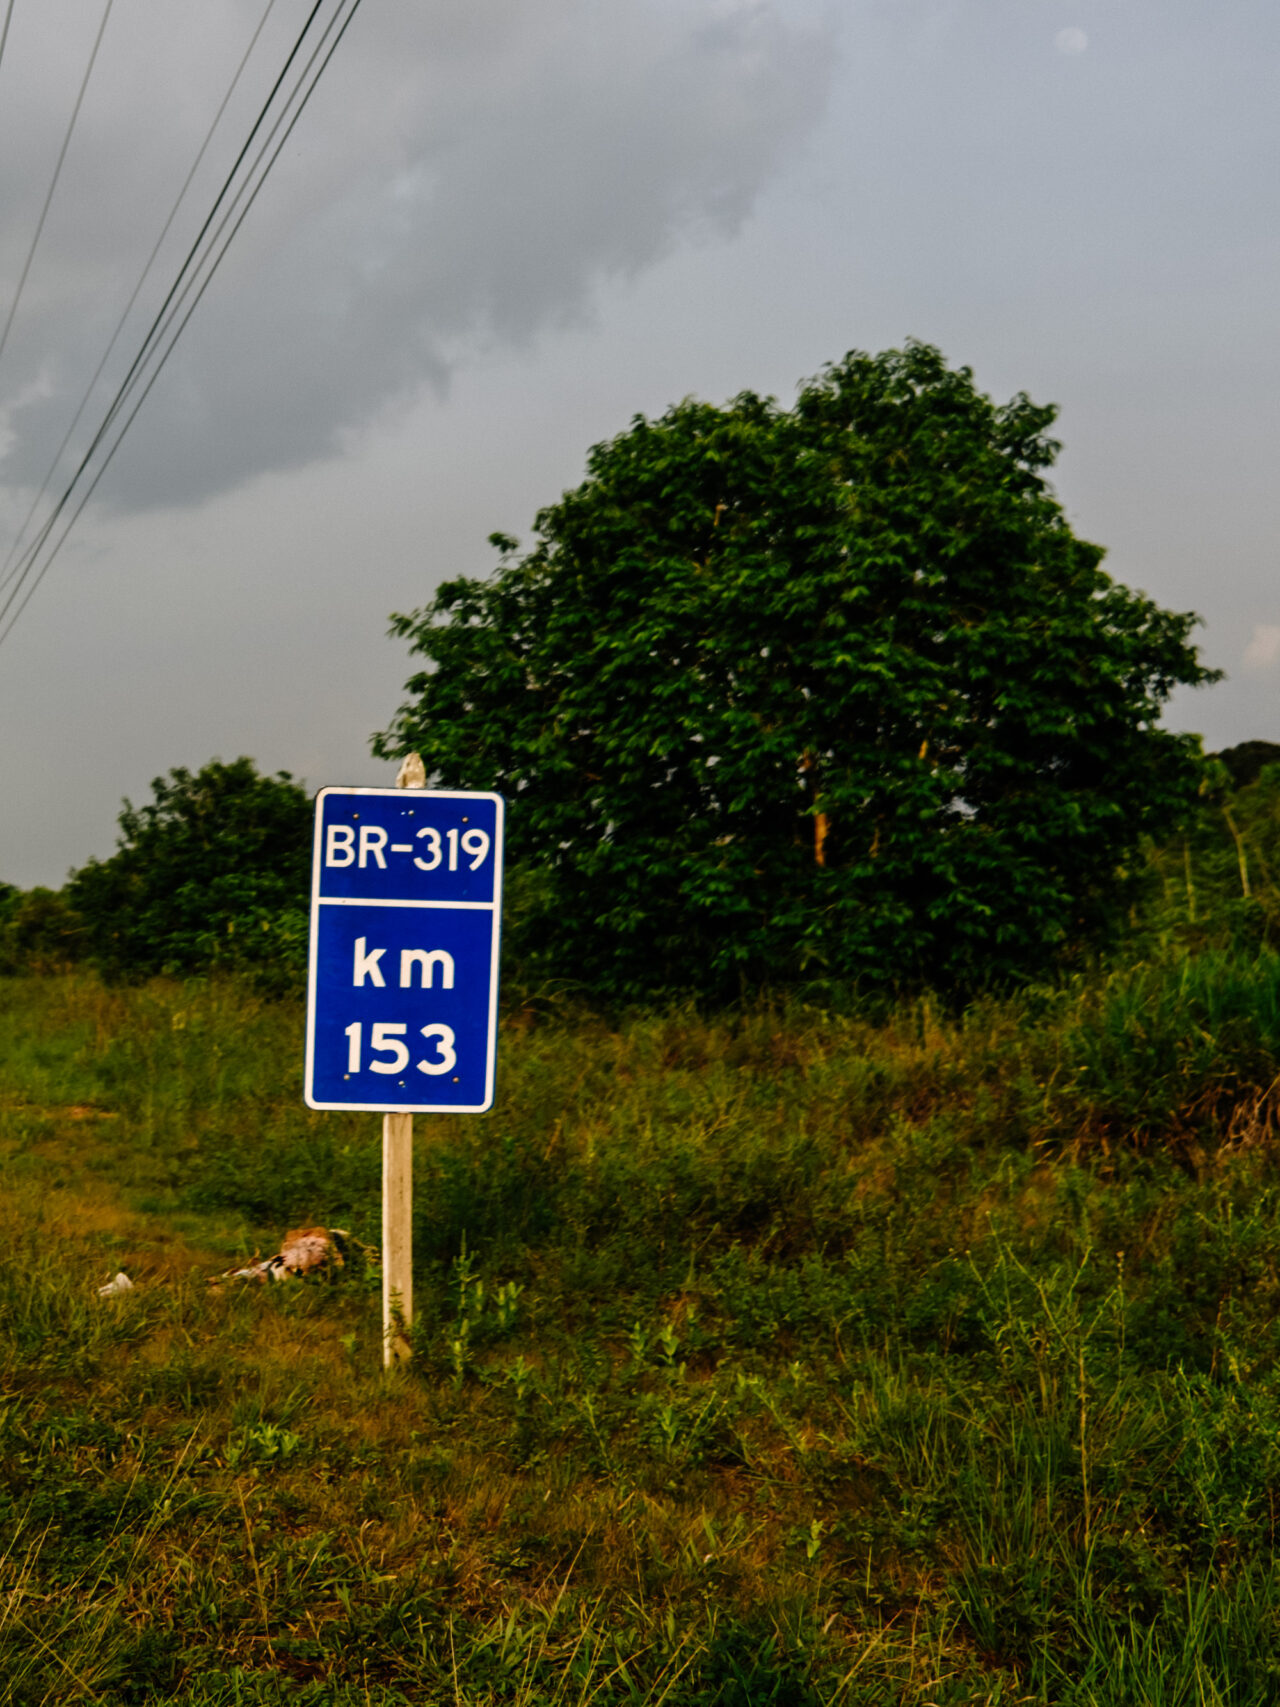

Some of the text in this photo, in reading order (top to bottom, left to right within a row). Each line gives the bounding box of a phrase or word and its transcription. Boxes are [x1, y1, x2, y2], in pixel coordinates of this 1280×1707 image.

[325, 824, 490, 872] BR-319
[353, 936, 455, 990] km
[344, 1022, 457, 1076] 153
